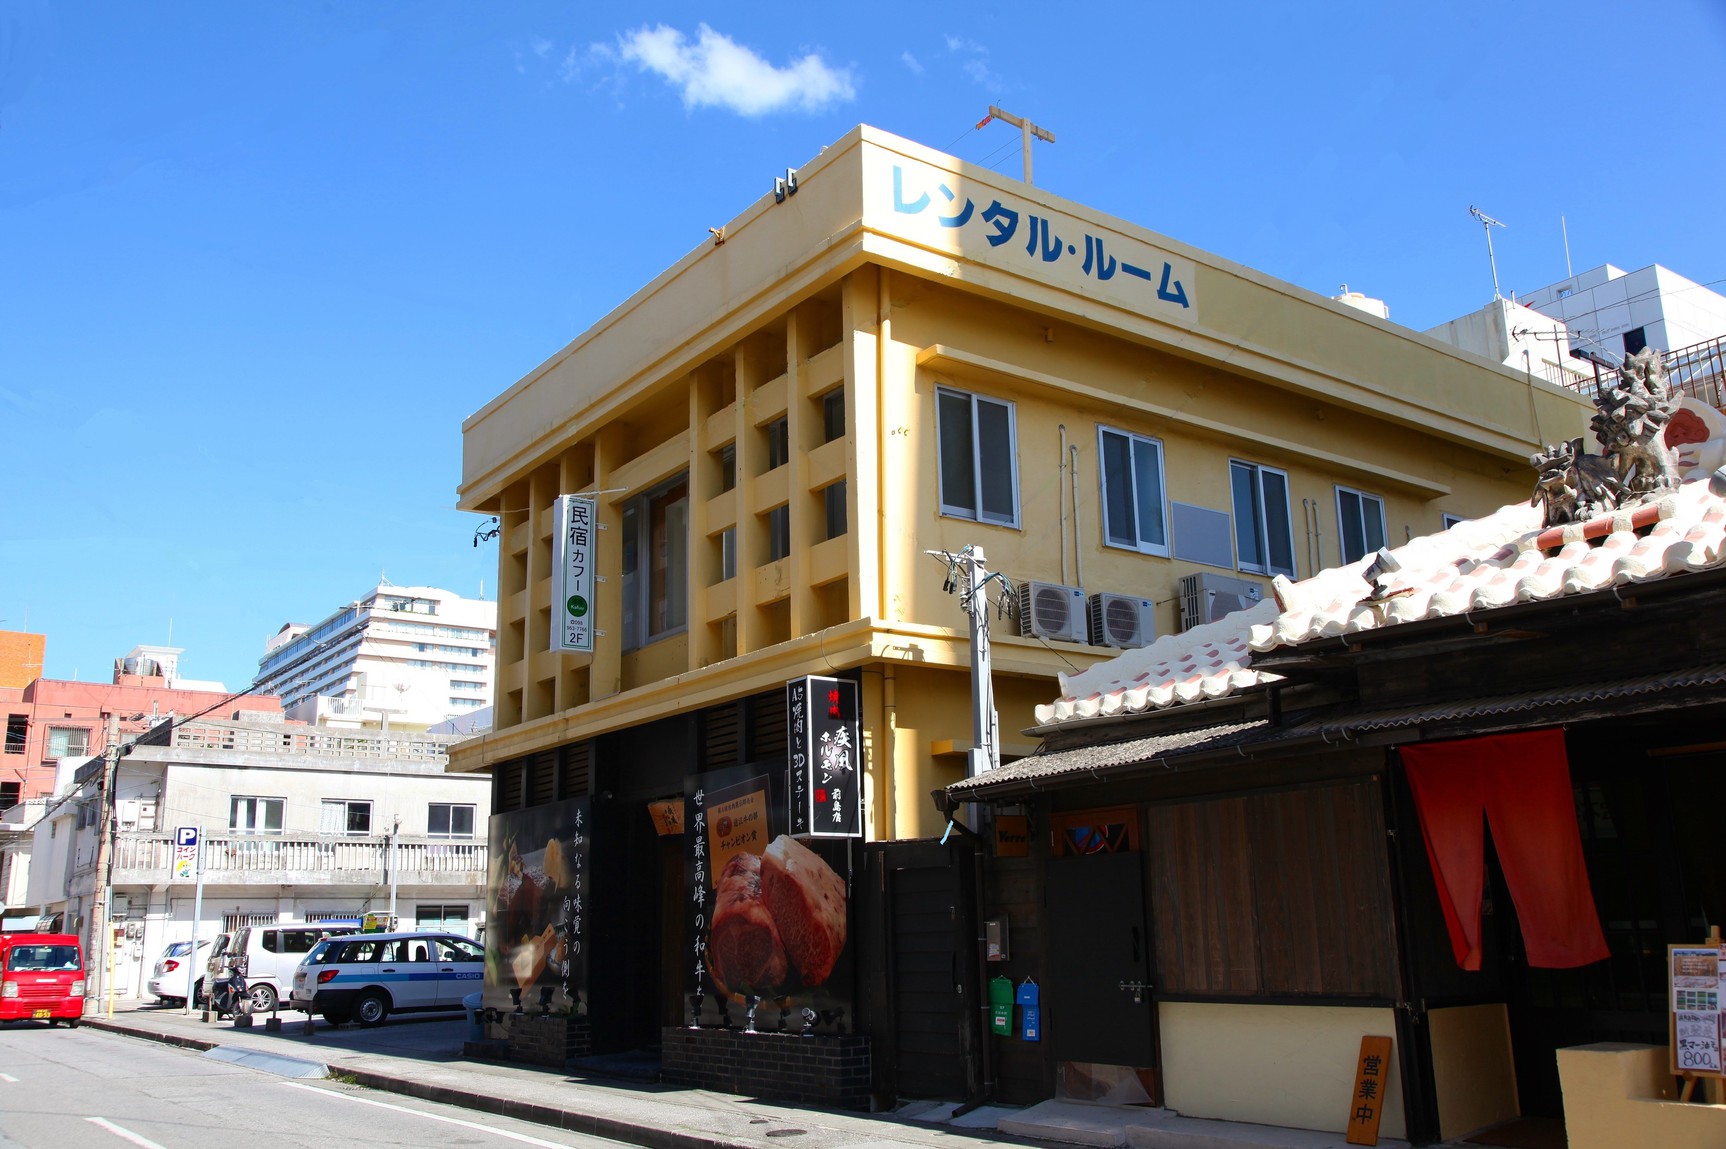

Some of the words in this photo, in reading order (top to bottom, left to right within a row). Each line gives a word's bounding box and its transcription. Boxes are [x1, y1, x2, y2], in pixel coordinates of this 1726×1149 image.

[893, 165, 1190, 308] レンタル・ルーム
[569, 505, 589, 592] 民宿カフー
[569, 632, 584, 644] 2F
[819, 731, 833, 785] ホルモン
[180, 828, 196, 845] P
[720, 830, 758, 852] チャンピオン賞
[571, 808, 583, 956] 未知なる味覚の
[1356, 1054, 1382, 1125] 営業中
